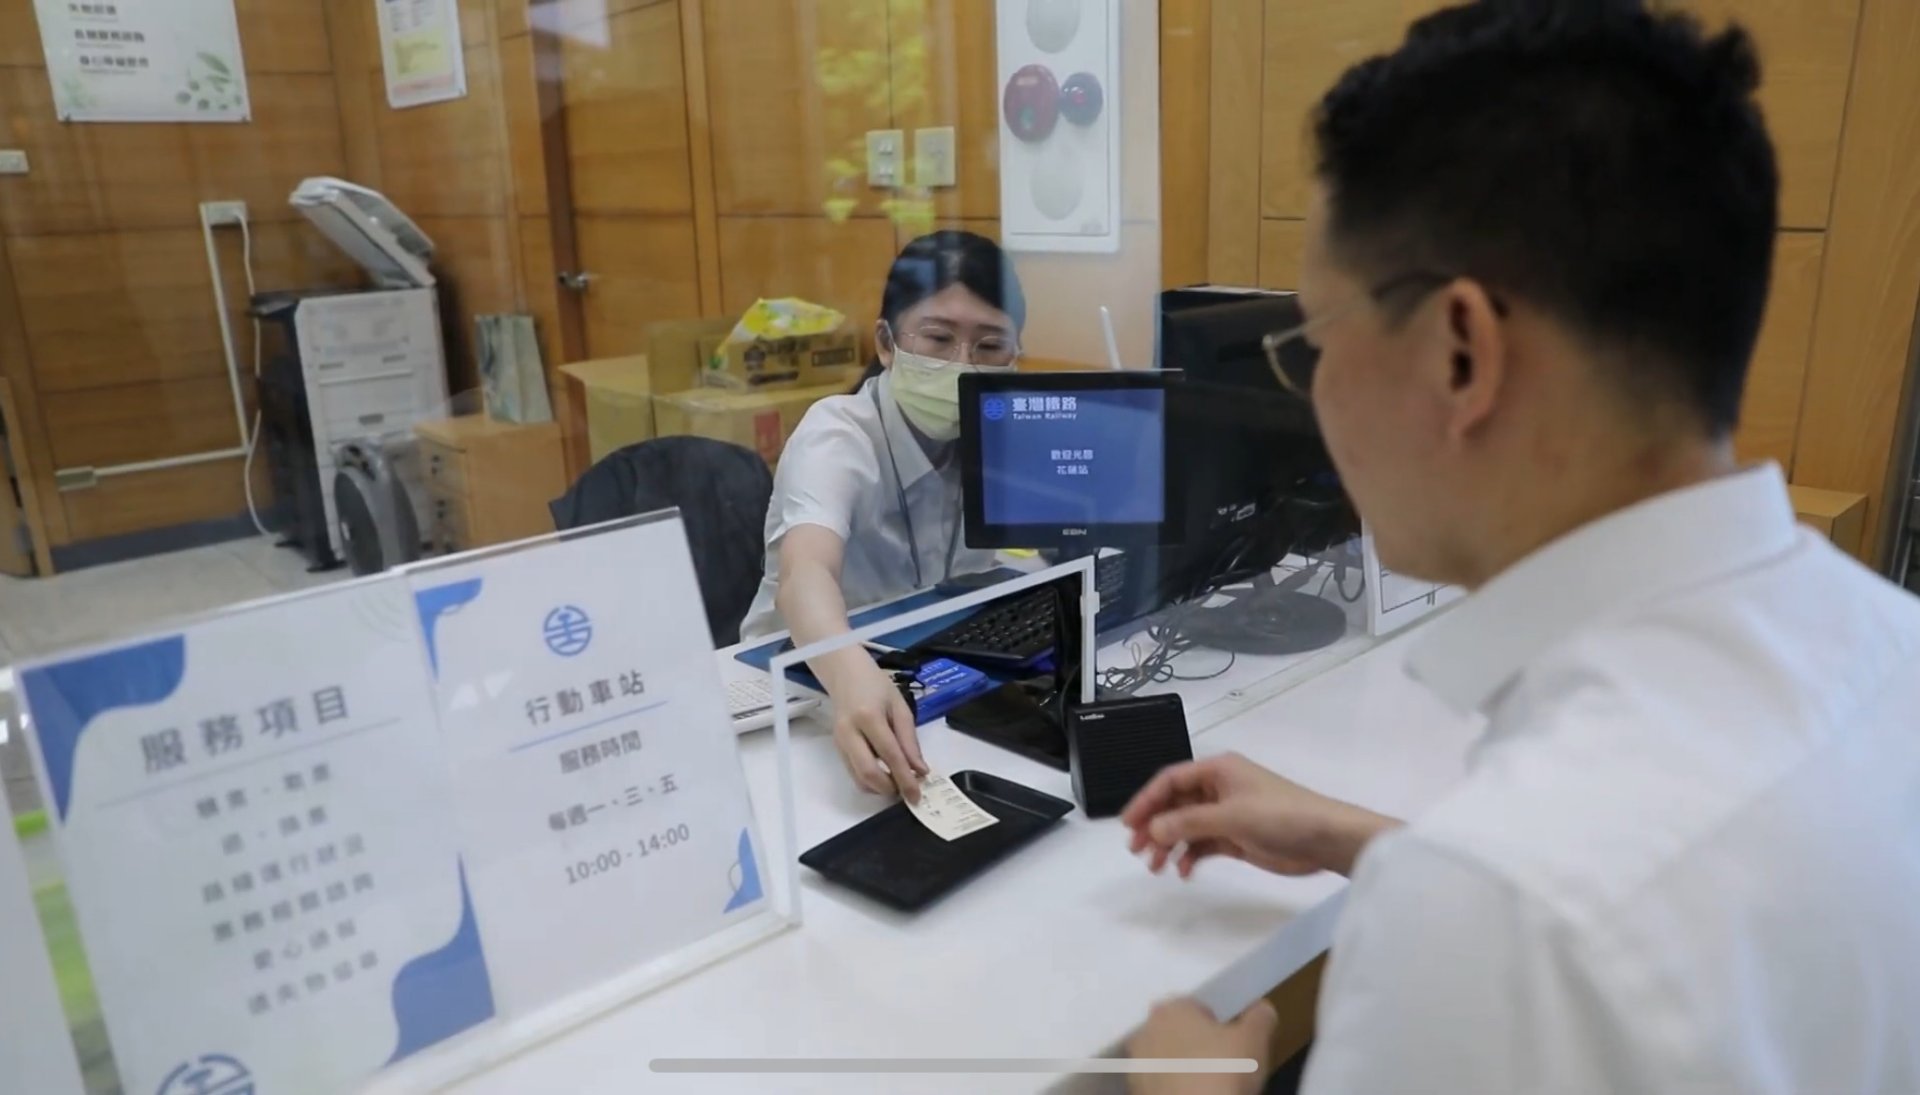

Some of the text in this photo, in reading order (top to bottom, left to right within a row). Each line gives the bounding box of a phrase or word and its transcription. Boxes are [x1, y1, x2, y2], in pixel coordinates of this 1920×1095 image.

[1012, 396, 1077, 412] 臺灣鐵路
[1013, 412, 1077, 421] Taiwan Railway
[525, 669, 645, 726] 行動車站
[140, 685, 349, 774] 服務項目
[559, 729, 643, 774] 服務時間
[565, 848, 622, 885] 10:00
[637, 822, 691, 858] 14:00
